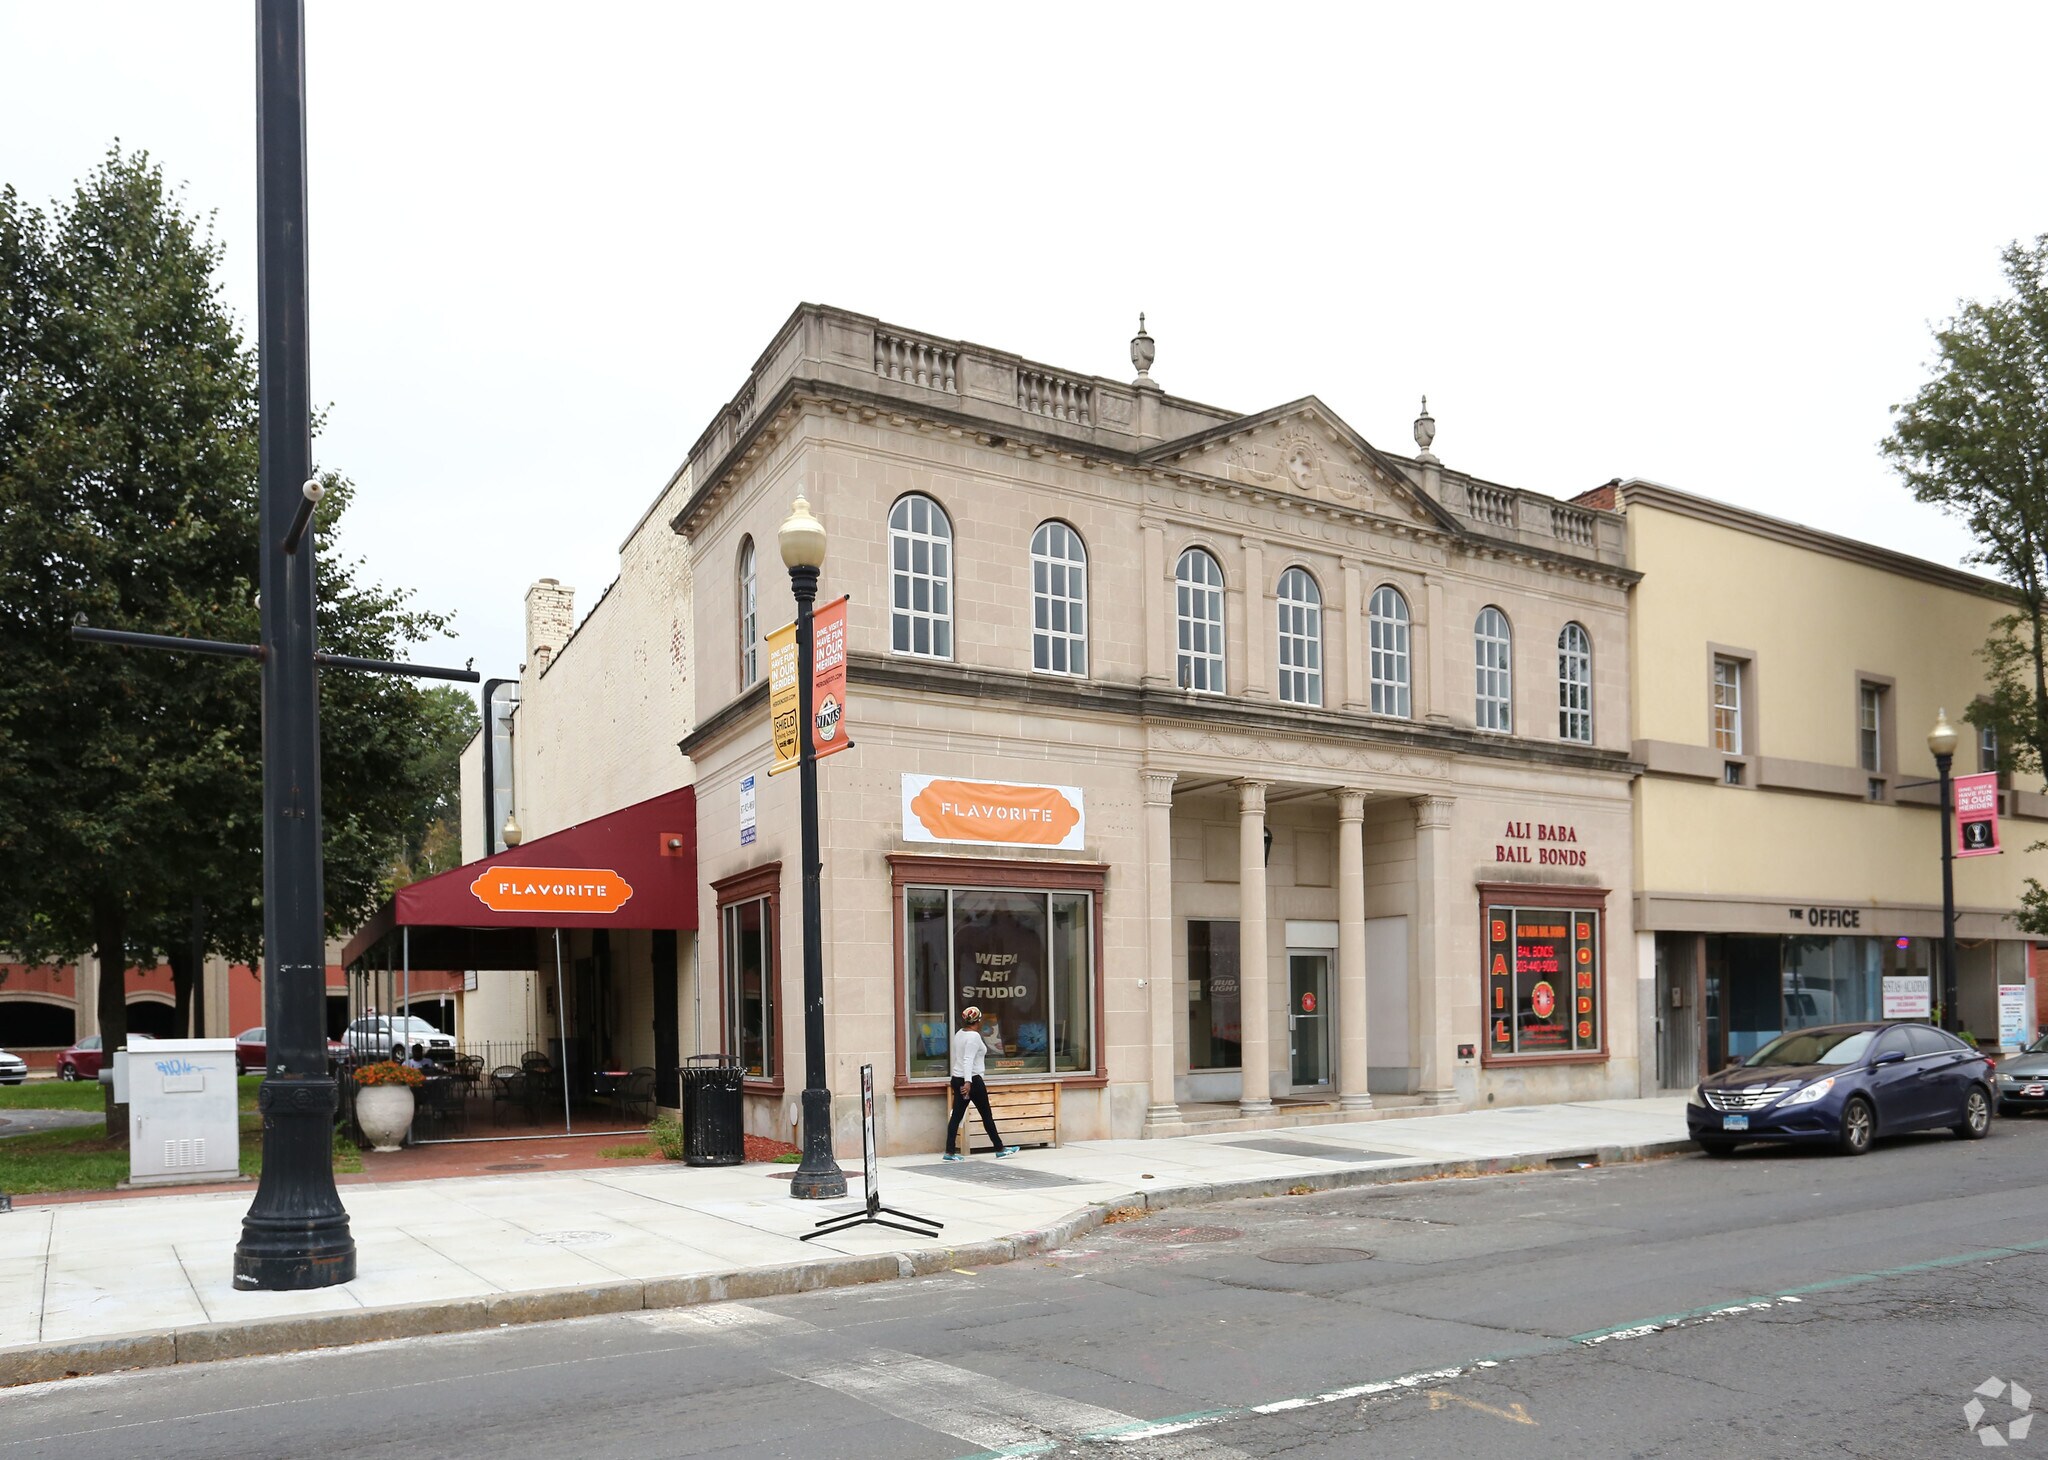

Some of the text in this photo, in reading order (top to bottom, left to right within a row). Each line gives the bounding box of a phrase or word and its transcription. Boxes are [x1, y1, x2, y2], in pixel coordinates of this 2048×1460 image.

[829, 620, 839, 632] VISIT
[839, 618, 843, 627] &
[790, 642, 795, 651] &
[816, 627, 843, 649] HAVE FUN
[816, 638, 843, 662] IN OUR
[771, 650, 795, 670] HAVE FUN
[816, 651, 843, 673] MERIDEN
[771, 661, 796, 683] IN OUR
[771, 673, 796, 693] MERIDEN
[776, 715, 795, 733] SHIELD
[1959, 803, 1993, 812] MERIDEN
[1971, 795, 1993, 804] OUR
[941, 802, 1053, 822] FLAVORITE
[1505, 821, 1577, 843] ALI BABA
[1495, 845, 1587, 867] BAIL BONDS
[499, 883, 607, 897] FLAVORITE
[1789, 907, 1860, 928] THE OFFICE
[975, 952, 1018, 966] WEPA
[1517, 945, 1553, 957] BAIL BONDS
[980, 970, 1011, 982] ART
[962, 985, 1027, 999] STUDIO
